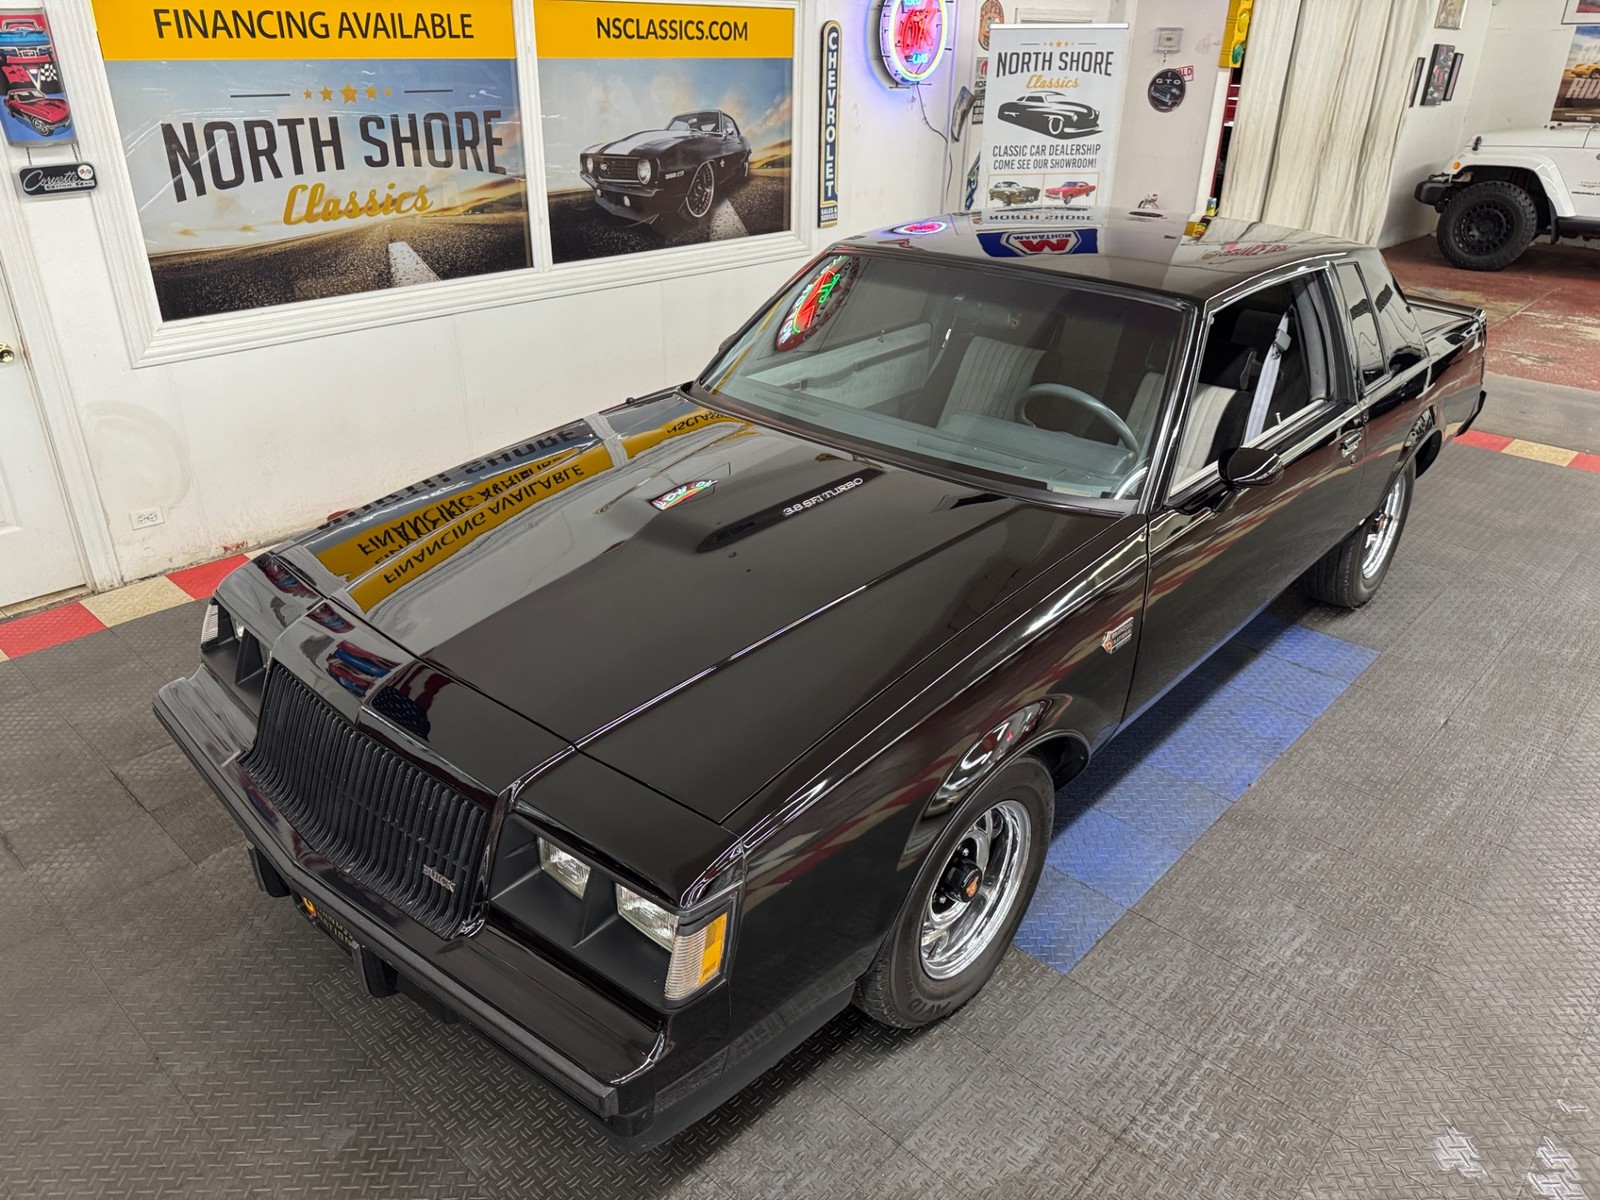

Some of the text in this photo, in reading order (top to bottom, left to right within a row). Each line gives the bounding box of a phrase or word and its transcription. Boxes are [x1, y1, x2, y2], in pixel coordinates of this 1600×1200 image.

[154, 8, 475, 40] FINANCING AVAILABLE
[596, 17, 749, 41] NSCLASSICS.COM
[996, 51, 1114, 78] NORTH SHORE
[1026, 74, 1080, 89] Classics
[1565, 78, 1600, 99] RID
[824, 32, 838, 197] CHEVROLET
[160, 108, 508, 204] NORTH SHORE
[992, 144, 1101, 157] CLASSIC CAR DEALERSHIP
[993, 158, 1097, 170] COME SEE OUR SHOWROOM!
[23, 169, 81, 191] Corvette
[281, 181, 434, 227] Classics
[822, 477, 864, 499] TURBO
[422, 864, 457, 893] BUICK
